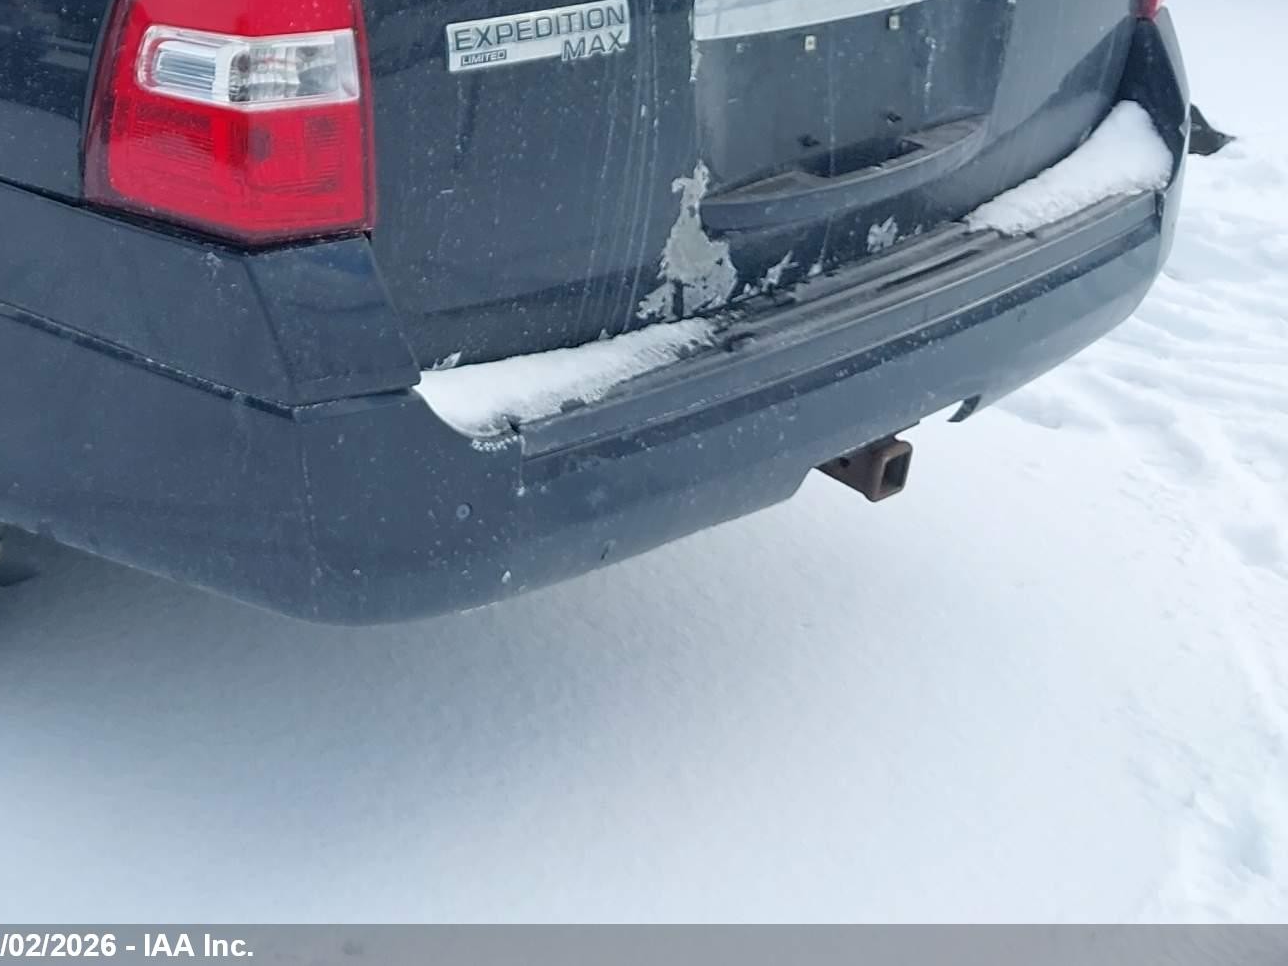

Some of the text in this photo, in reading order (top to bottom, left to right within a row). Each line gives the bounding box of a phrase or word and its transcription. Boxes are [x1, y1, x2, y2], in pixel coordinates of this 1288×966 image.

[454, 3, 626, 52] EXPEDITION
[461, 49, 507, 67] LIMITED
[560, 29, 626, 62] MAX
